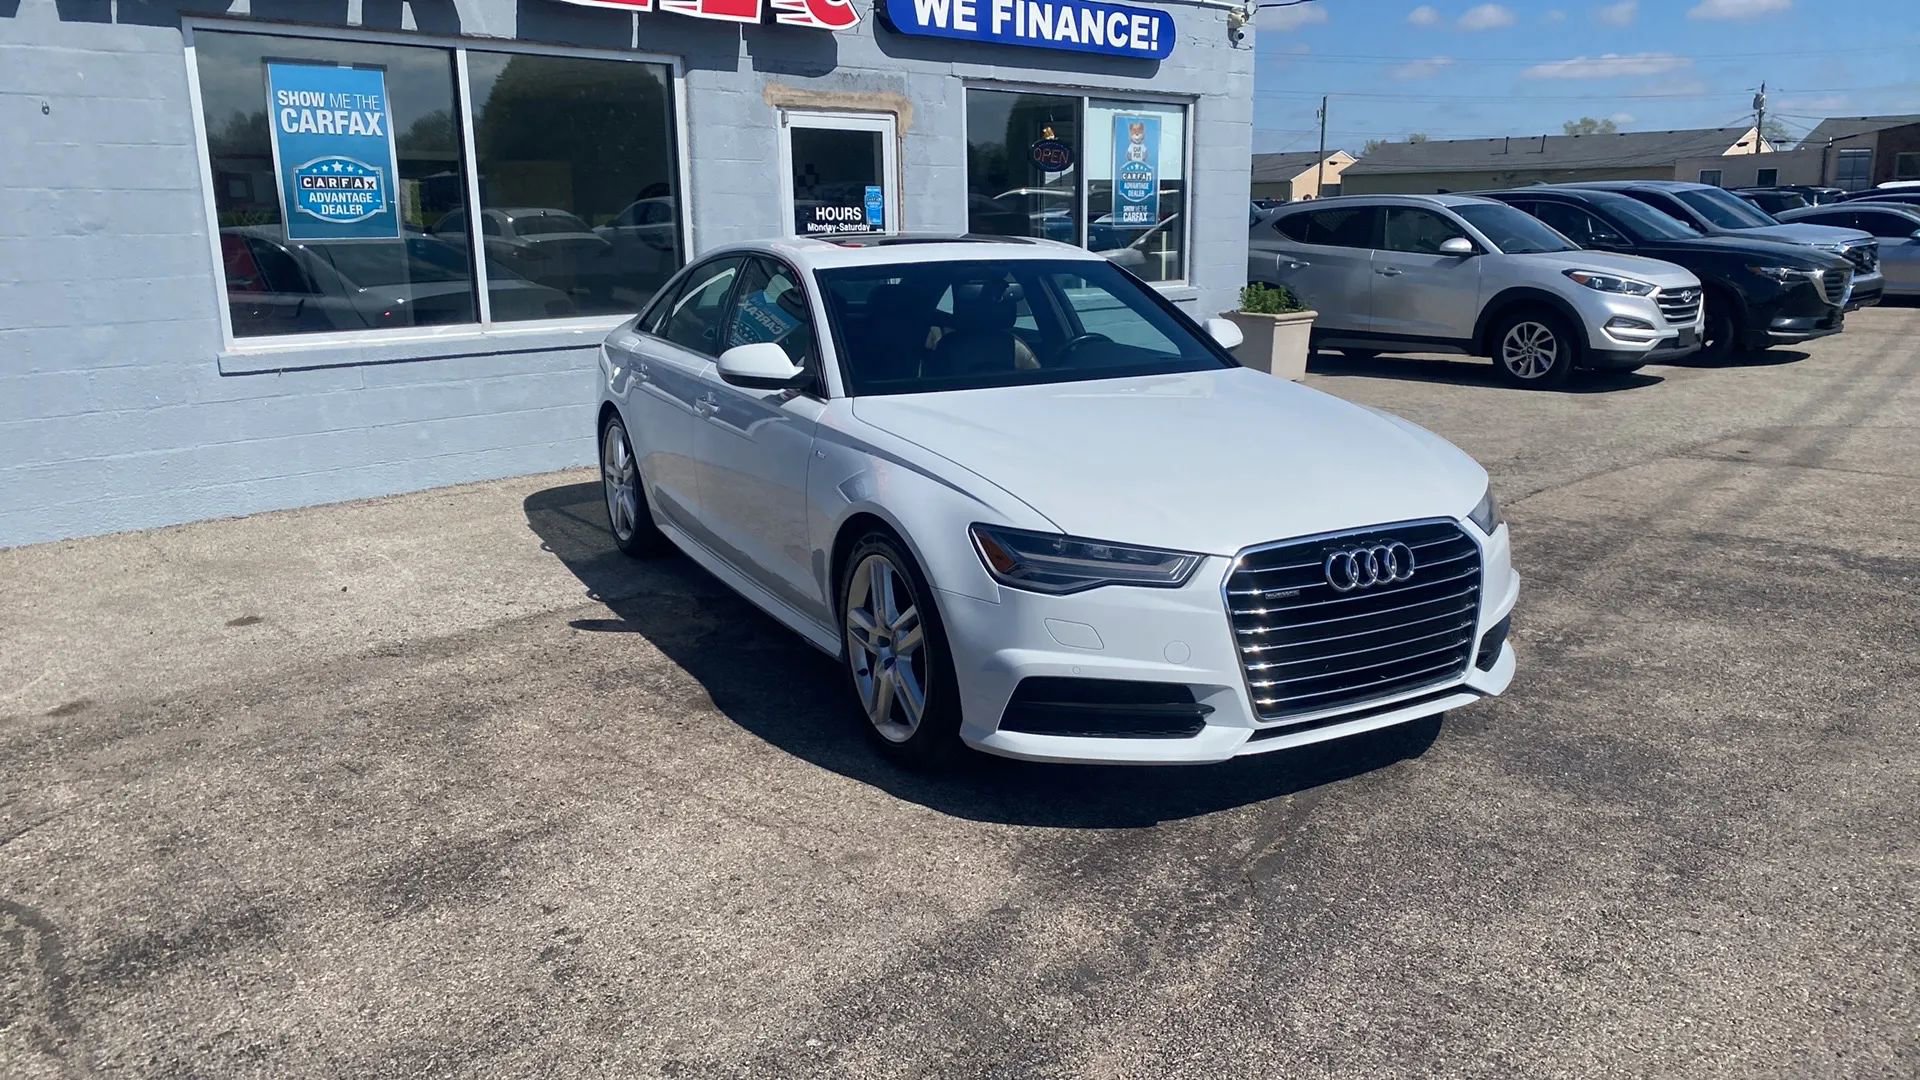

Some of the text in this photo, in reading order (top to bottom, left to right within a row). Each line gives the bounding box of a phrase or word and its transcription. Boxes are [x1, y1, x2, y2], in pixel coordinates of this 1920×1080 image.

[912, 0, 1160, 51] WE FINANCE!
[277, 90, 380, 110] SHOW ME THE
[280, 108, 384, 136] CARFAX
[1034, 147, 1069, 163] OPEN
[302, 176, 376, 190] CARFAX
[309, 192, 373, 203] ADVANTAGE
[321, 204, 364, 215] DEALER
[815, 206, 862, 220] HOURS
[1123, 212, 1148, 222] CARFAX
[807, 222, 871, 233] Monday-Saturday
